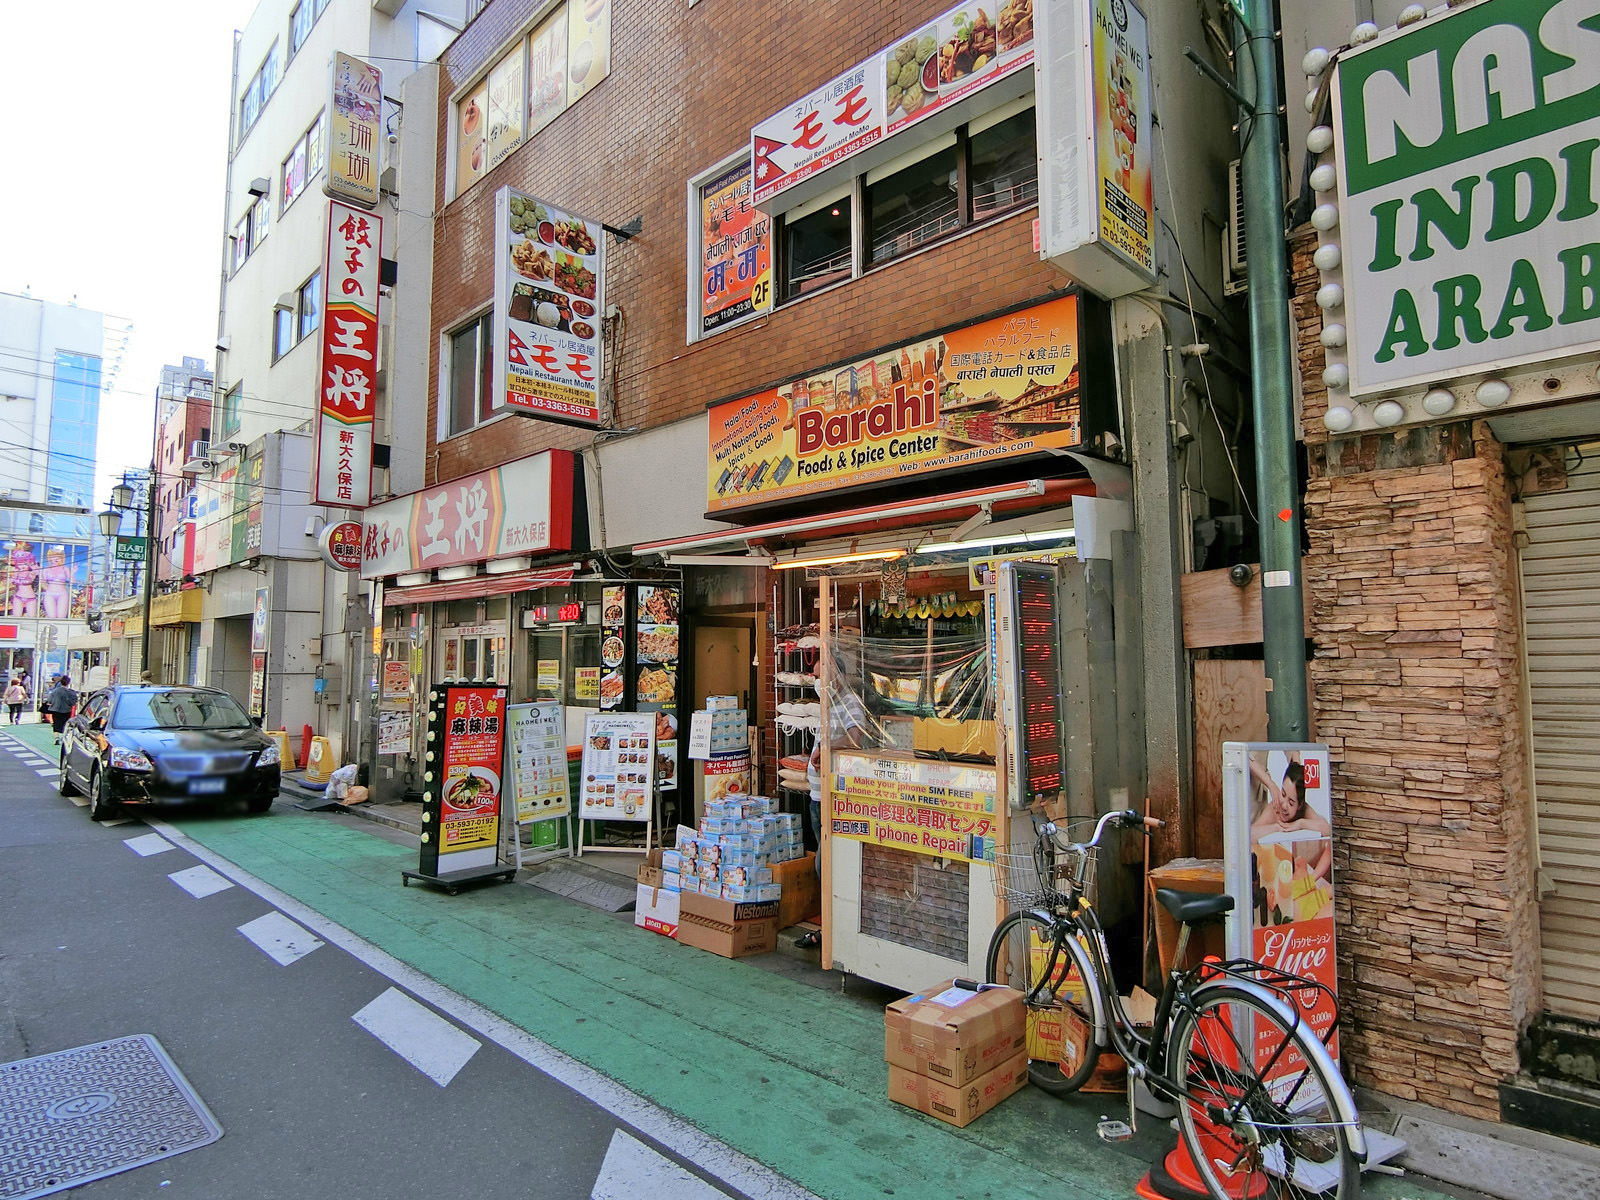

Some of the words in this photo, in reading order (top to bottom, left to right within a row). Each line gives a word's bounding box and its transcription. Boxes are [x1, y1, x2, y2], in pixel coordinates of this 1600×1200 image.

[1096, 7, 1113, 39] HAO
[1115, 28, 1128, 56] MEI
[1129, 44, 1144, 73] WEI
[790, 84, 873, 151] モモ
[794, 154, 813, 170] Nepali
[813, 135, 848, 161] Restaurant
[848, 124, 870, 141] MoMo
[820, 155, 832, 168] Tel.
[833, 130, 879, 161] 03-3363-5515
[338, 213, 373, 298] 餃子の
[1110, 229, 1153, 270] 03-5937-0192
[754, 280, 769, 306] 2F
[704, 312, 719, 327] Open:
[1003, 317, 1040, 332] バラヒ
[984, 328, 1059, 348] ハラルフード
[326, 315, 373, 411] 王将
[530, 344, 596, 382] モモ
[950, 344, 1072, 367] 国際電話カード&食品店
[957, 367, 987, 381] बाराही
[990, 364, 1023, 379] नेपाली
[1027, 364, 1056, 377] पसल
[509, 364, 534, 377] Nepali
[534, 369, 573, 386] Restaurant
[574, 378, 596, 391] MoMo
[513, 392, 528, 405] Tel.
[532, 396, 591, 418] 03-3363-5515
[724, 410, 741, 430] Halal
[741, 400, 760, 418] Foods
[798, 378, 937, 455] Barahi
[711, 424, 744, 453] International
[744, 410, 764, 429] Calling
[763, 398, 779, 416] Cards
[715, 445, 731, 463] Multi
[732, 427, 759, 452] National
[759, 415, 780, 437] Foods,
[337, 430, 354, 500] 新大久保店
[728, 451, 746, 468] Spices
[754, 431, 775, 450] Goods
[797, 457, 833, 478] Foods
[837, 450, 847, 469] &
[851, 445, 885, 468] Spice
[889, 433, 939, 459] Center
[899, 460, 921, 473] Web:
[923, 439, 1034, 468] www.barahifoods.com
[422, 479, 489, 561] 王将
[505, 520, 546, 546] 新大久保店
[853, 776, 876, 788] Make
[877, 780, 895, 791] your
[897, 782, 927, 794] iphone
[928, 786, 946, 797] SIM
[947, 788, 974, 800] FREE!
[1304, 763, 1319, 785] 301
[900, 792, 916, 802] SIM
[445, 817, 495, 830] 03-5937-0192
[832, 819, 869, 835] 即日修理
[833, 795, 996, 837] iphone修理&買取センター
[875, 823, 919, 844] iphone
[922, 831, 967, 853] Repair
[1291, 933, 1331, 950] リラクゼーション
[1255, 927, 1328, 1004] Elyce
